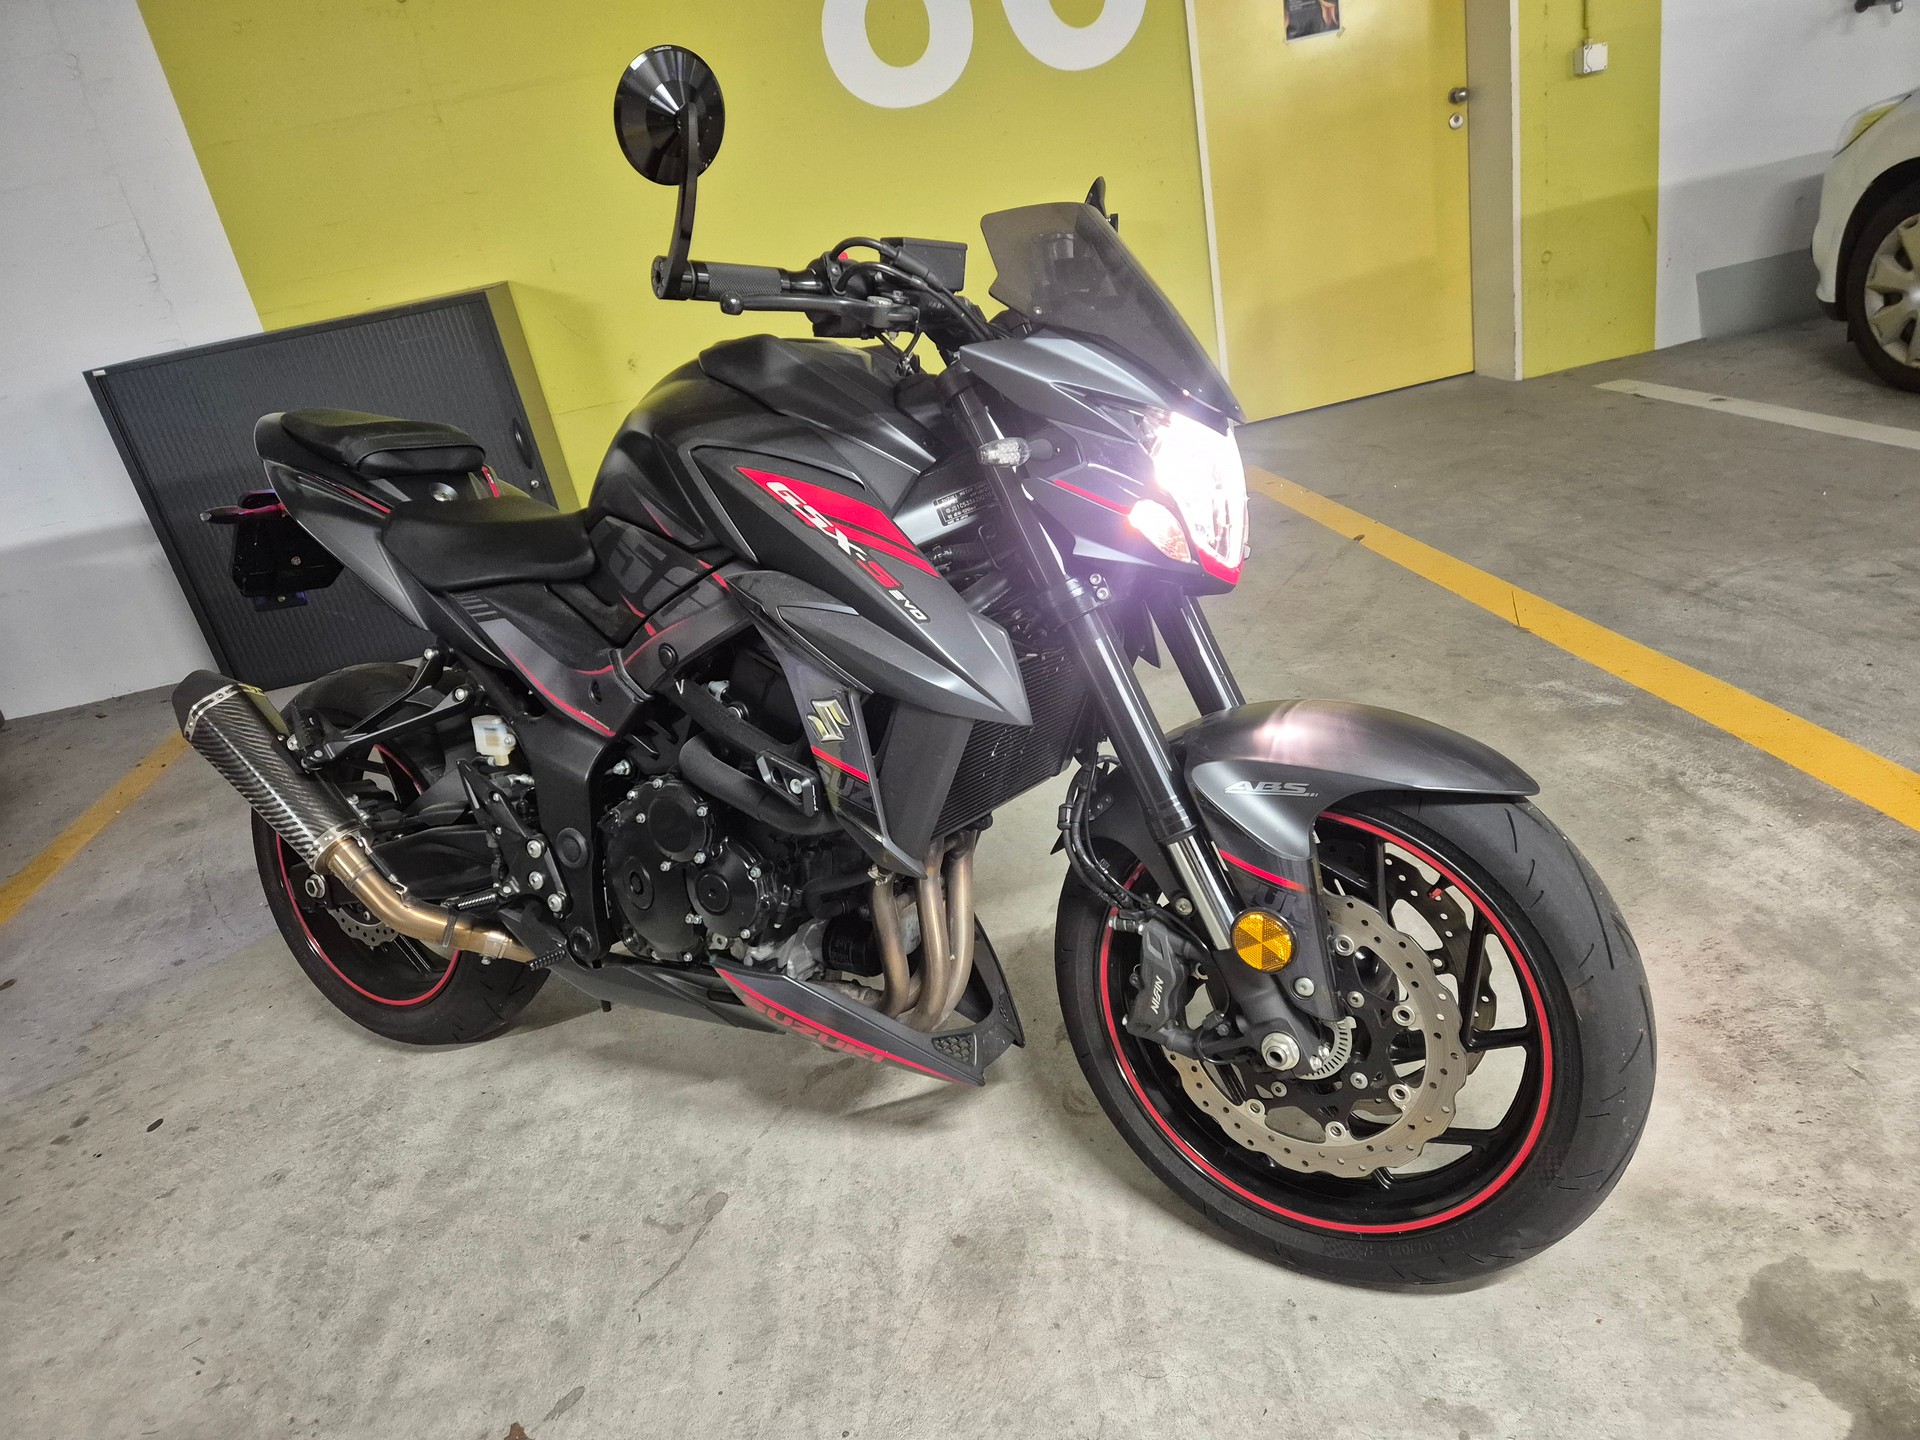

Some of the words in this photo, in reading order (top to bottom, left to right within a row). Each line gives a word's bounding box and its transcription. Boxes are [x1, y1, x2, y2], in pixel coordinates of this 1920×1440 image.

[765, 481, 902, 589] GSX-S
[888, 589, 928, 621] EVO
[1224, 780, 1310, 797] ABS
[1150, 974, 1164, 1015] NISSIN
[743, 993, 886, 1064] SUZUKI
